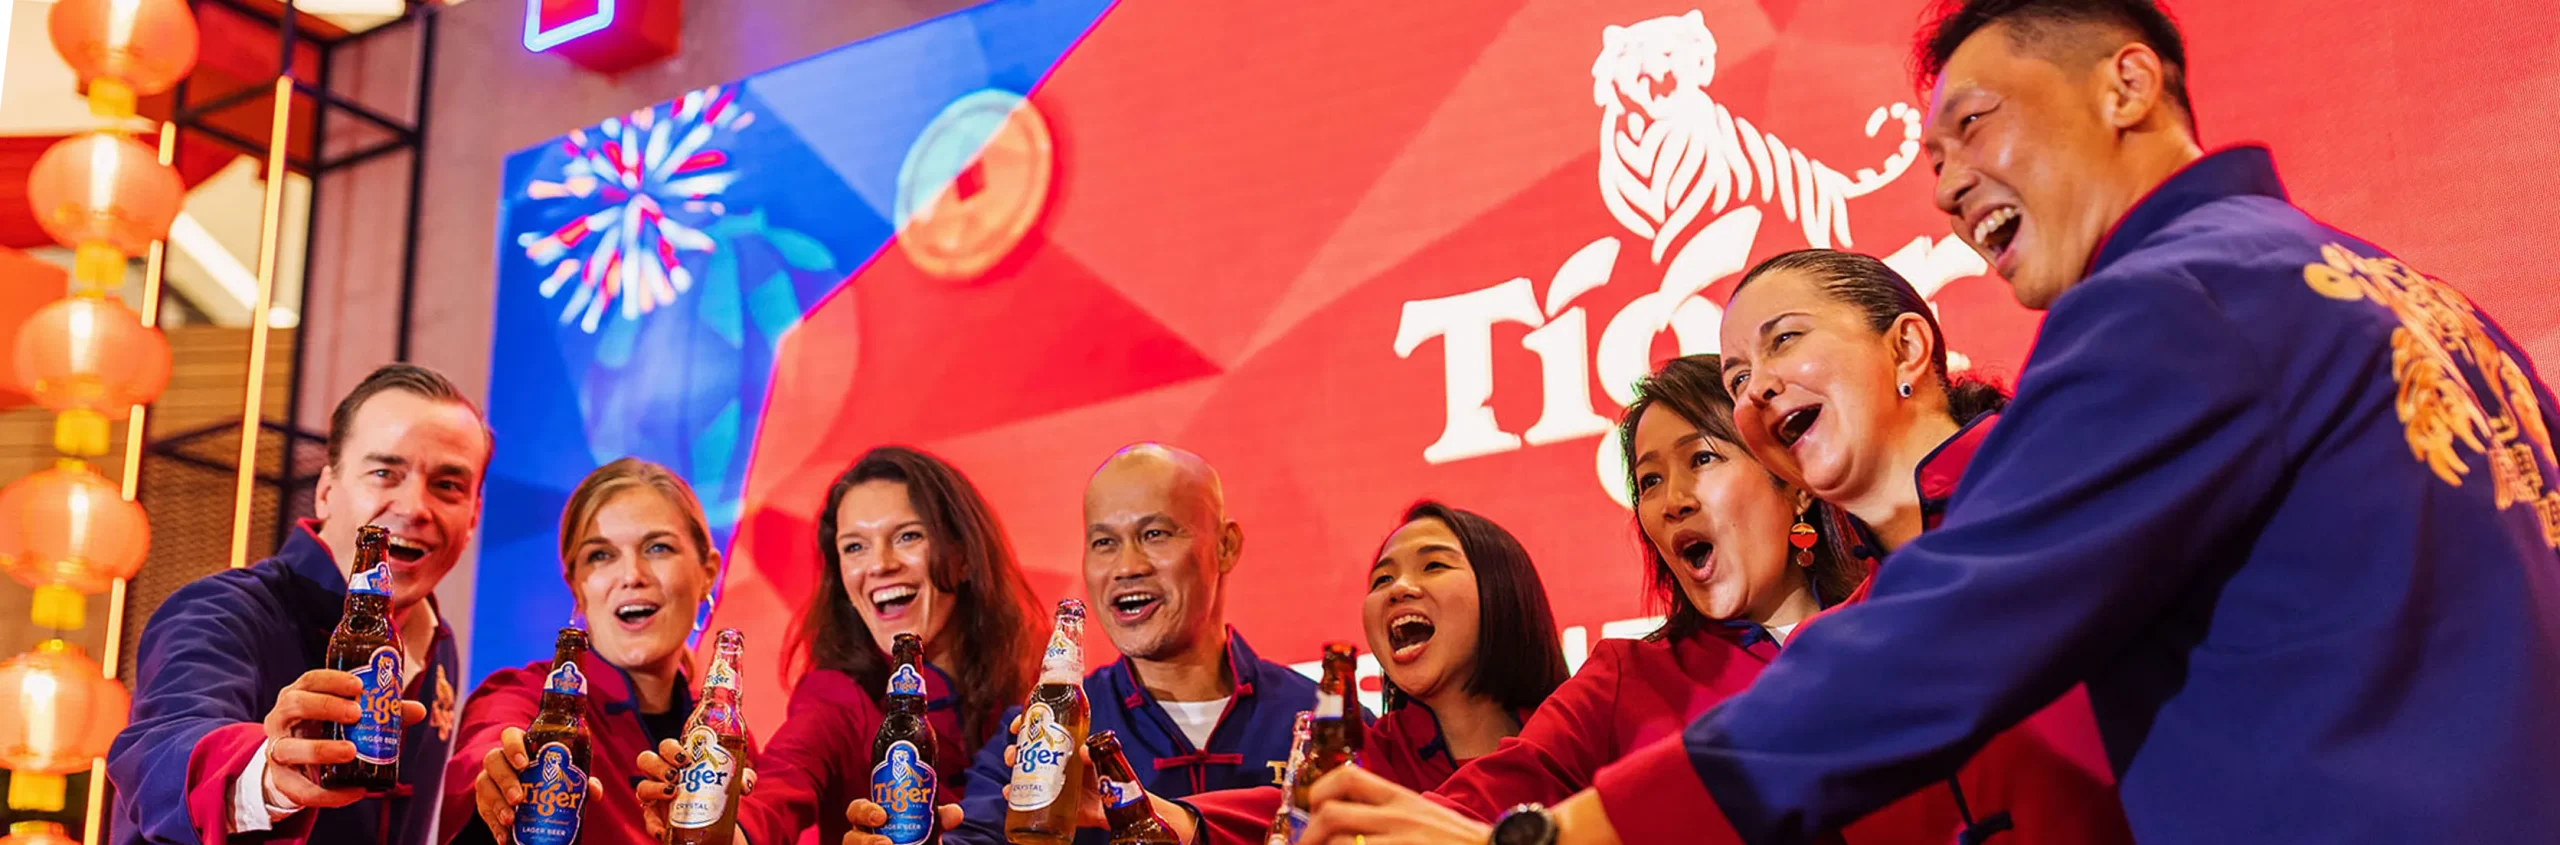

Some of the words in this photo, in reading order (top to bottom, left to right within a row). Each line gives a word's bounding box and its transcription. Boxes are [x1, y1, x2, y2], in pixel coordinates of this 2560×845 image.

[520, 782, 581, 816] Tiger
[874, 779, 931, 813] Tiger
[547, 828, 566, 836] BEER
